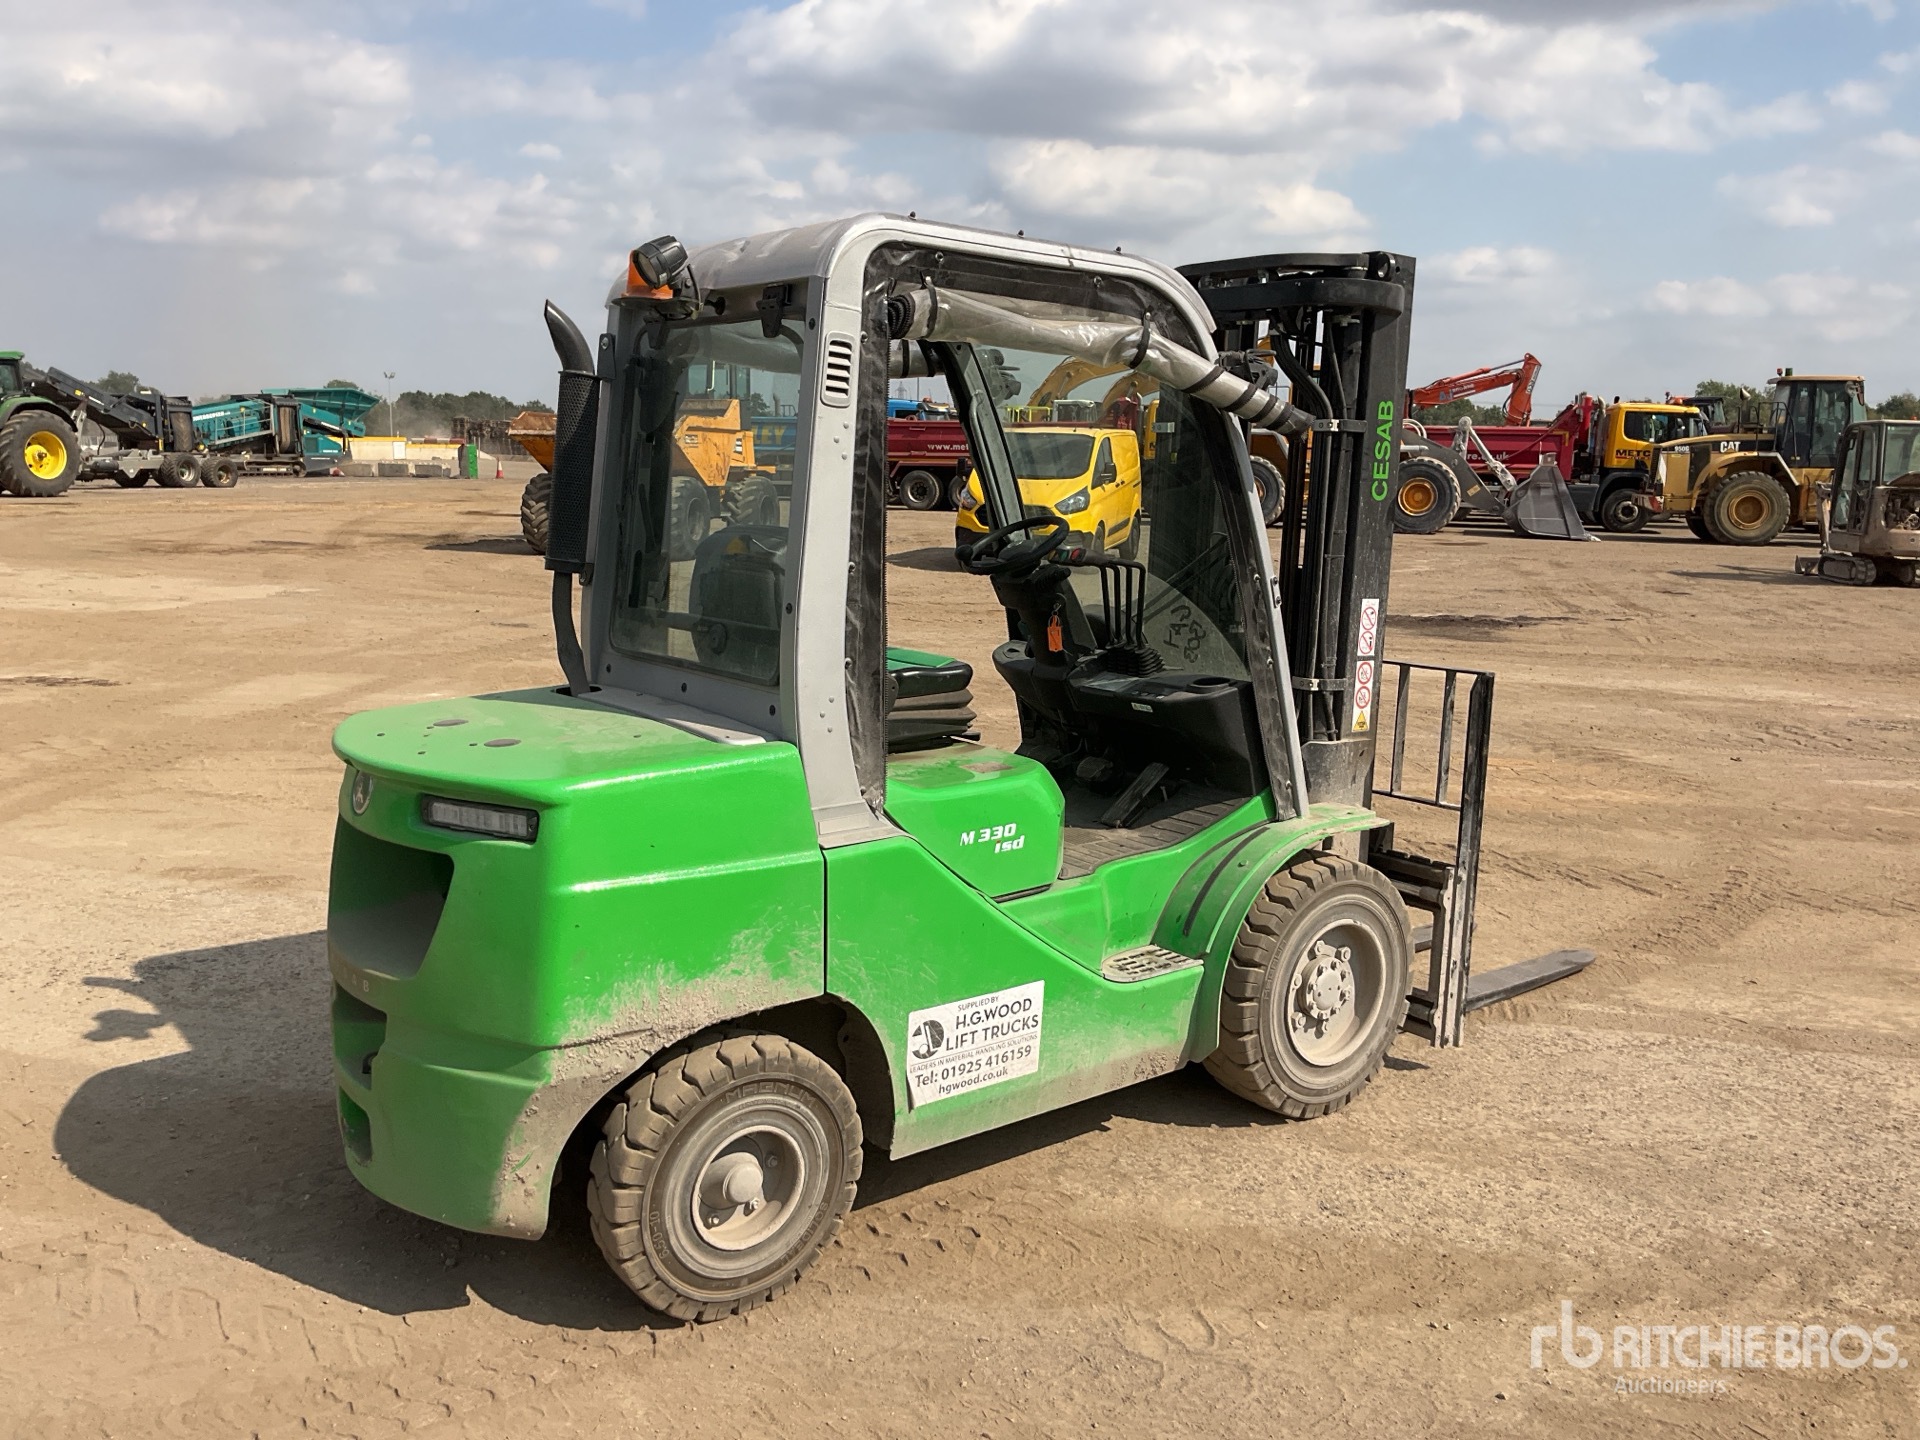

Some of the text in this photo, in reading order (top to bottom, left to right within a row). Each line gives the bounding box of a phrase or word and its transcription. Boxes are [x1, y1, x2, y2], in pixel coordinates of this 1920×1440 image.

[1371, 401, 1394, 501] CESAB
[1467, 451, 1509, 460] re..uk
[1720, 441, 1741, 453] CAT
[960, 823, 1016, 847] M 330
[955, 998, 1032, 1030] H.G.WOOD
[957, 995, 1000, 1012] SUPPLIED BY
[945, 1014, 1039, 1051] LIFT TRUCKS
[909, 1062, 937, 1073] LEADERS
[945, 1052, 974, 1064] MATERIAL
[975, 1042, 1006, 1056] HANDLING
[1006, 1034, 1038, 1048] SOLUTIONS
[915, 1045, 1032, 1087] Tel: 01925 416159
[725, 1081, 817, 1108] MAGNUM
[938, 1067, 1008, 1095] hgwood.co.uk
[650, 1211, 670, 1259] 6.50-10
